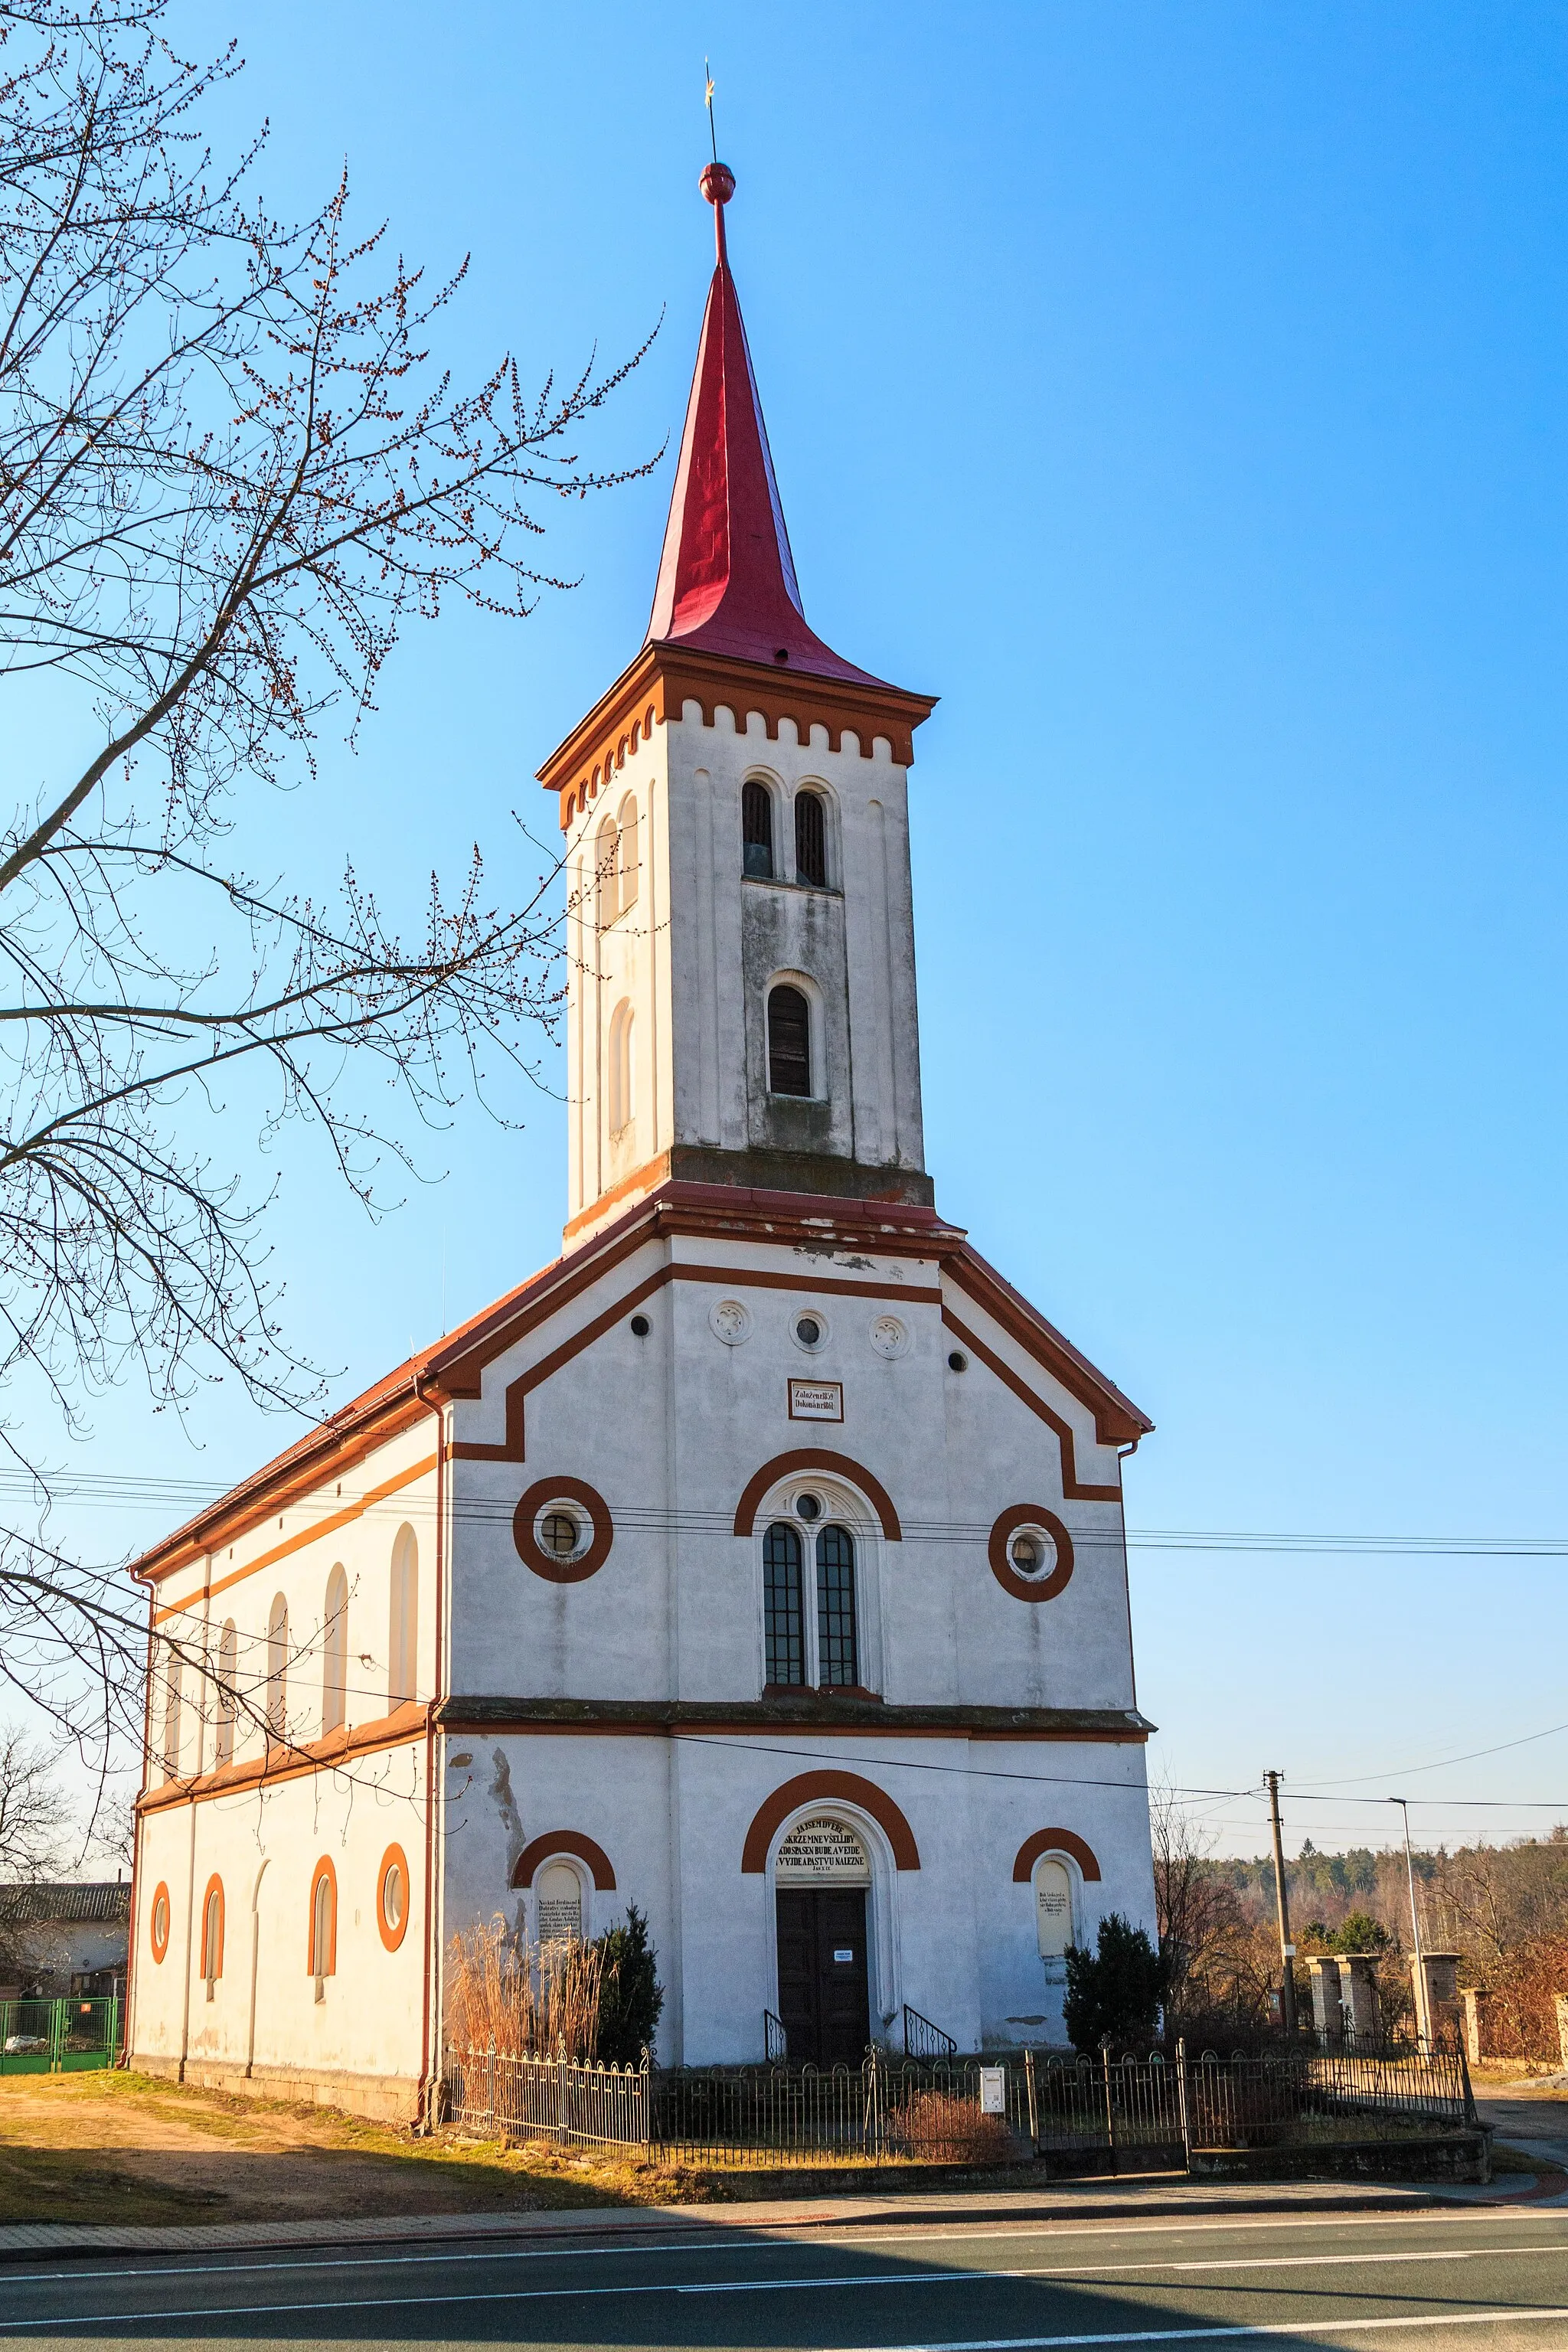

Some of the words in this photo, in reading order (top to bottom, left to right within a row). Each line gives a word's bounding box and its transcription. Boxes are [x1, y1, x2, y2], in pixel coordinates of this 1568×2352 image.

[804, 1821, 822, 1831] JSEM
[785, 1835, 807, 1844] SKRZE
[807, 1835, 823, 1844] MNE
[779, 1846, 792, 1855] KDO
[791, 1846, 814, 1855] SPASEN
[832, 1846, 838, 1854] A
[838, 1846, 861, 1854] VEJDE
[779, 1857, 802, 1866] VYJDE
[807, 1857, 834, 1866] PASTVU
[835, 1857, 864, 1866] NALEZNE
